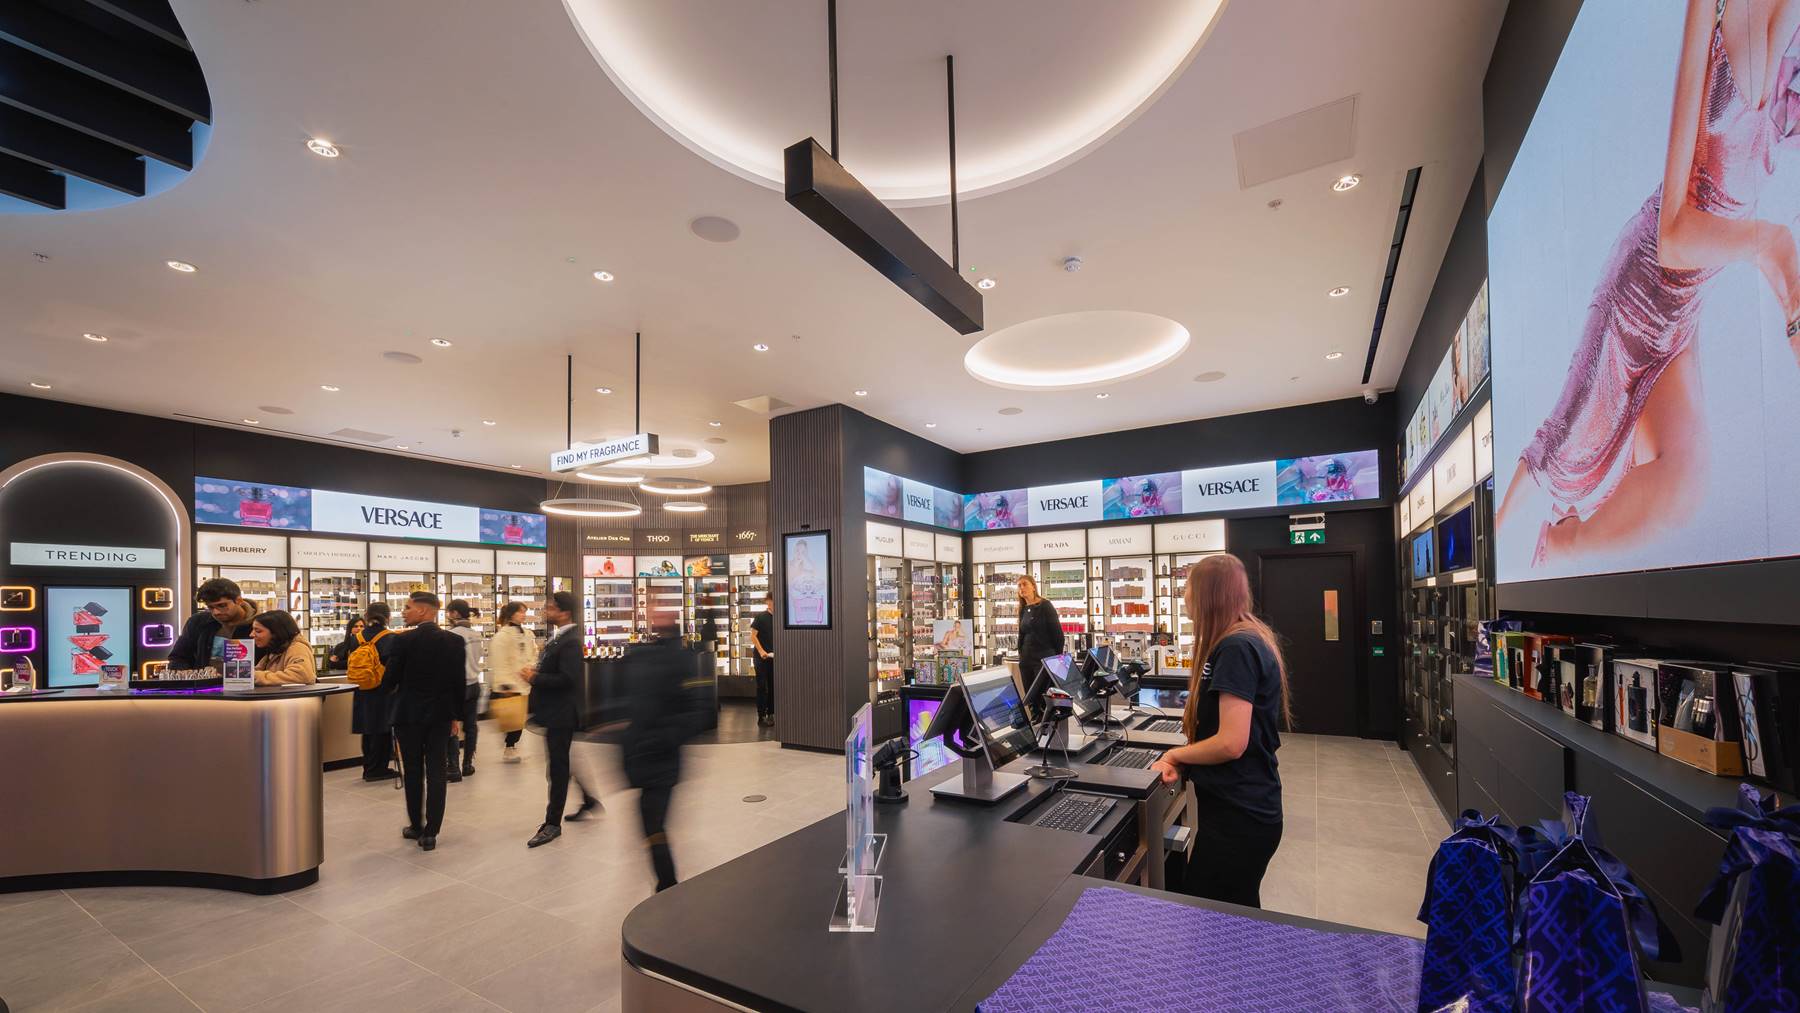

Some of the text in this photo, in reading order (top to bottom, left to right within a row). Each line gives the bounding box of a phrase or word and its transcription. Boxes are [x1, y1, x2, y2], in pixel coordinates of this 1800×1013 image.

[557, 439, 640, 466] FIND MY FRAGRANCE
[1198, 478, 1261, 497] VERSACE
[906, 493, 932, 511] VERSACE
[1040, 495, 1089, 512] VERSACE
[361, 505, 443, 530] VERSACE
[1173, 533, 1206, 541] GUCCI
[45, 550, 137, 563] TRENDING
[219, 546, 267, 554] BURBERRY
